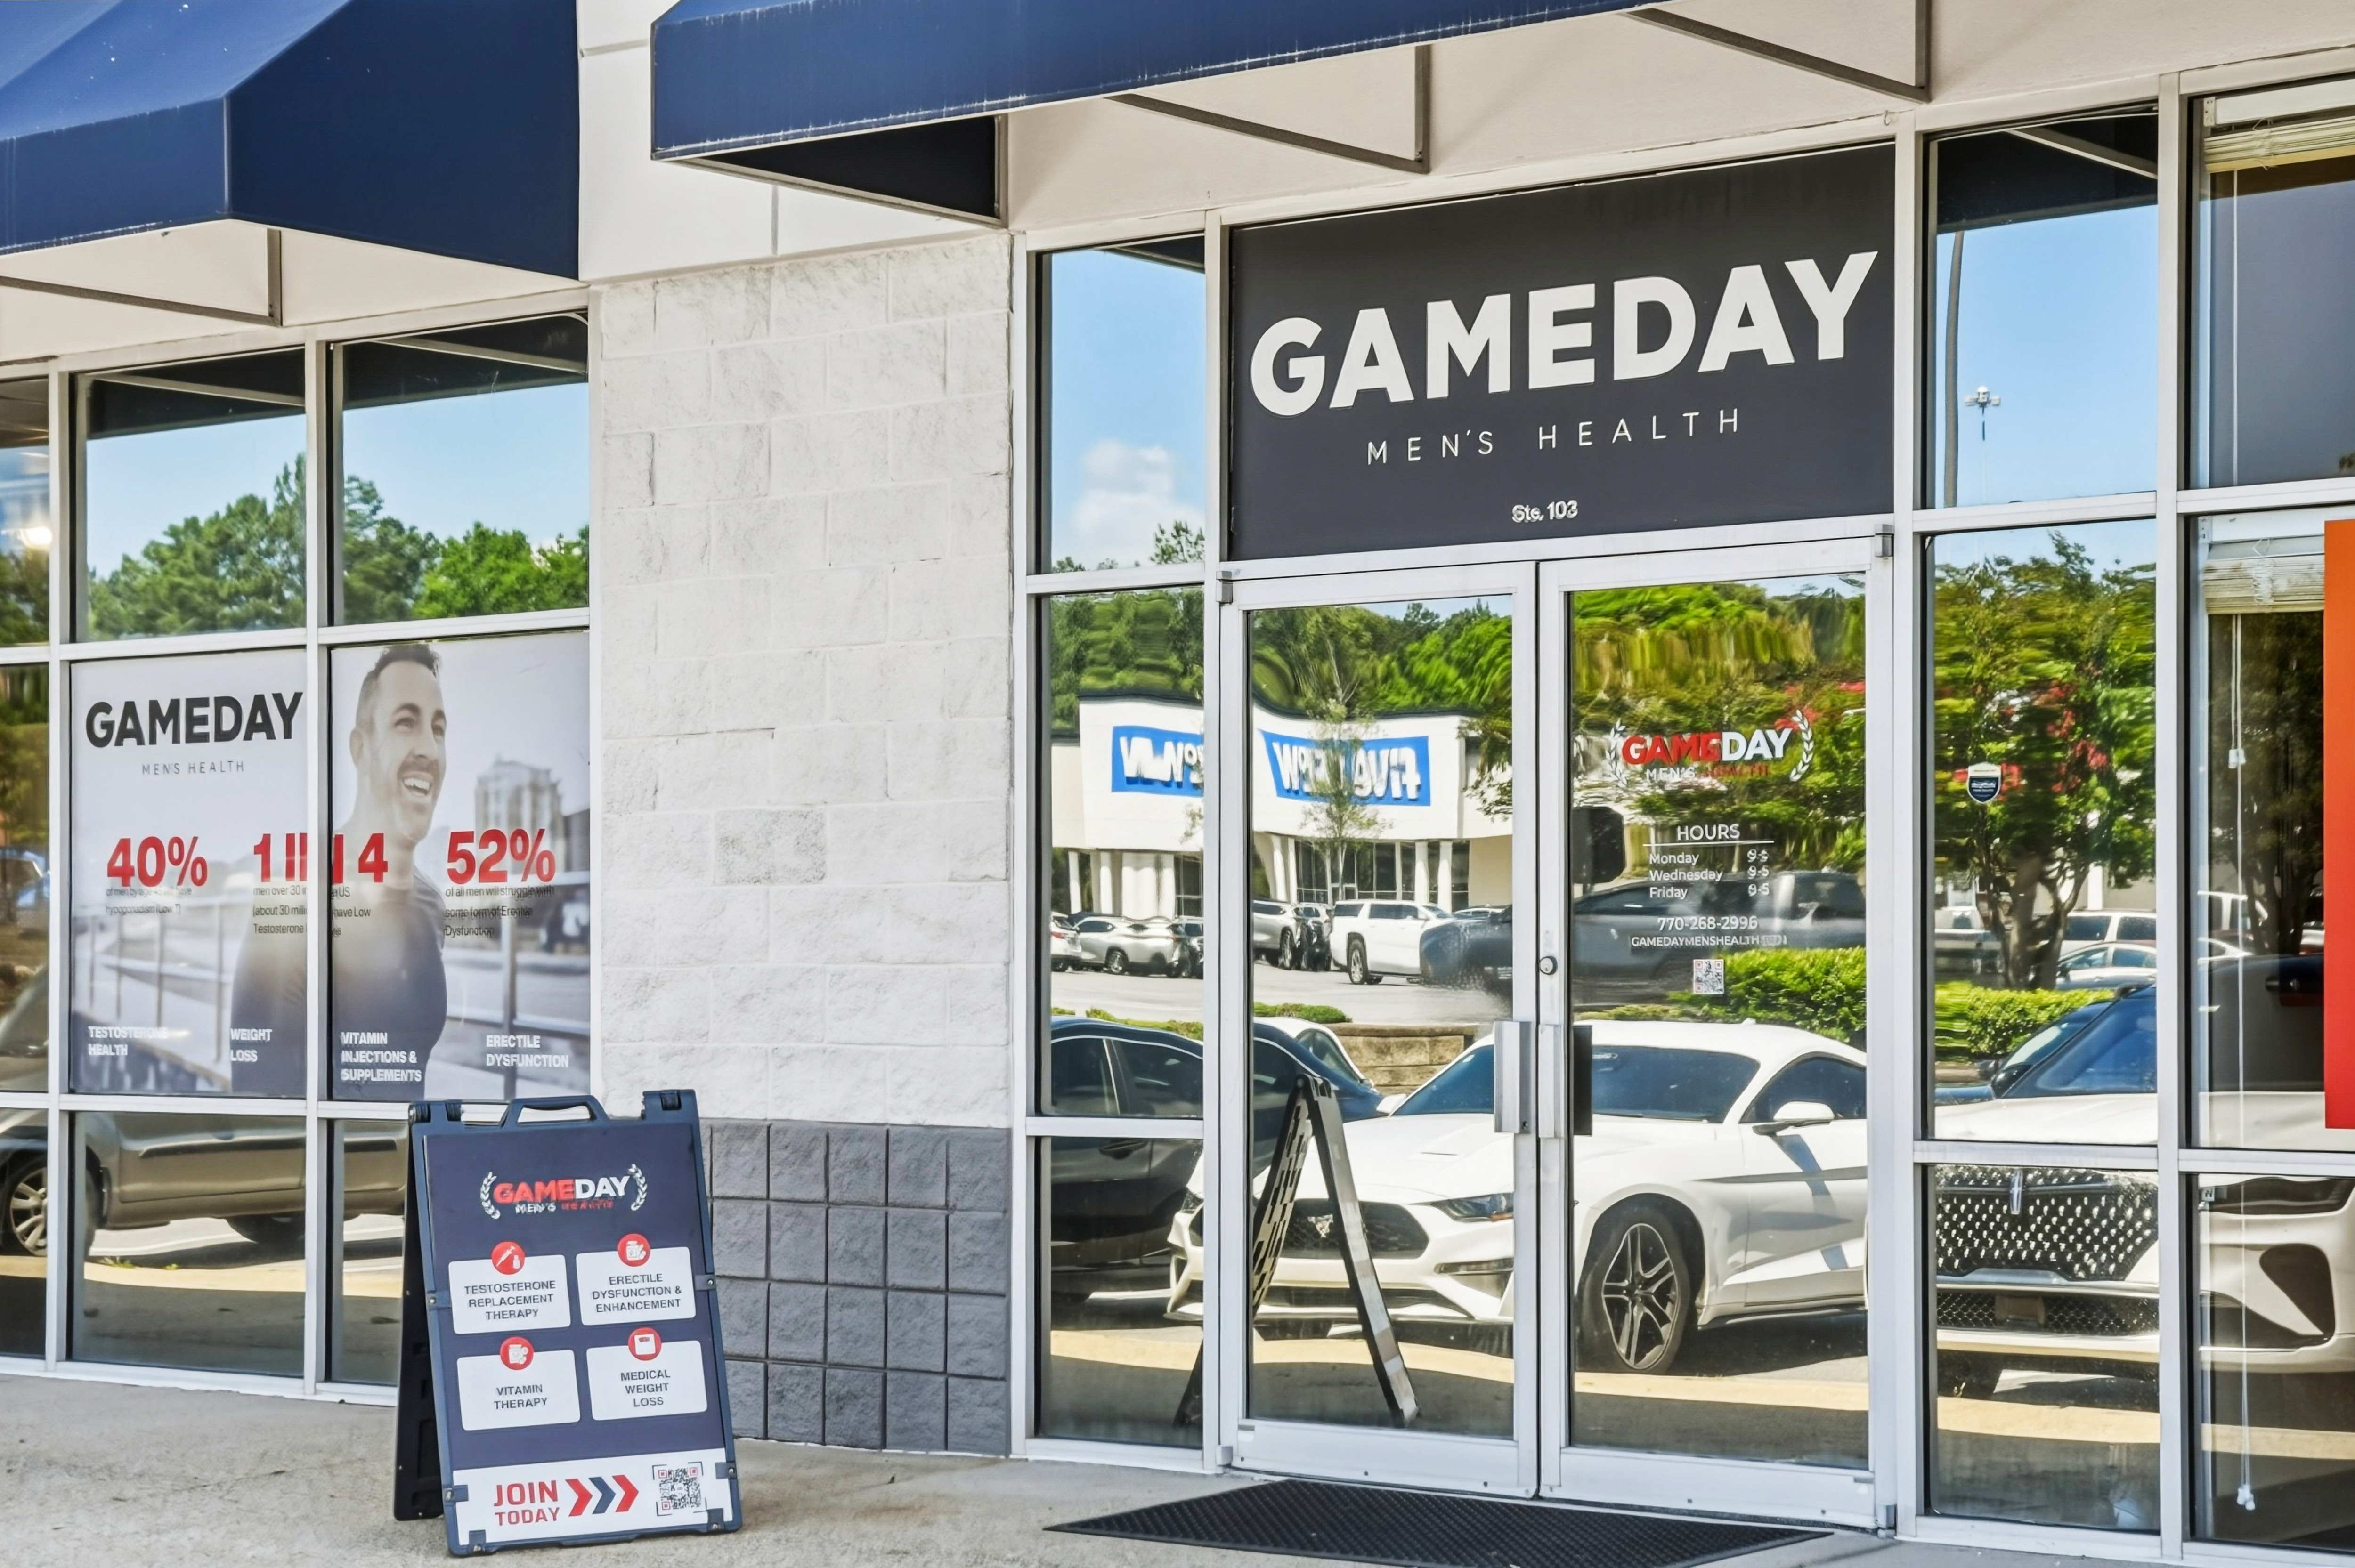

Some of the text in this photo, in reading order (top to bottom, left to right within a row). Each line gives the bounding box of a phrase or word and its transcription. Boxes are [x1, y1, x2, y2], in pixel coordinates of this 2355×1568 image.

[1250, 251, 1878, 416] GAMEDAY
[1368, 408, 1739, 465] MEN'S HEALTH
[1512, 500, 1578, 523] Ste. 103
[86, 692, 303, 748] GAMEDAY
[1622, 728, 1793, 765] GAMEDAY
[142, 760, 244, 775] MEN'S HEALTH
[1646, 767, 1696, 781] MEN'S
[1677, 823, 1740, 841] HOURS
[107, 836, 208, 887] 40%
[253, 833, 271, 882] 1
[358, 833, 388, 883] 4
[447, 828, 556, 885] 52%
[1649, 852, 1699, 865] Monday
[1649, 869, 1723, 882] Wednesday
[253, 887, 270, 896] men
[271, 887, 288, 895] over
[291, 885, 301, 895] 30
[339, 886, 350, 897] US
[446, 887, 454, 897] of
[455, 886, 464, 897] all
[466, 888, 484, 896] men
[486, 886, 499, 896] will
[1649, 883, 1770, 900] Friday 9-5
[253, 905, 307, 916] (about 30 milli
[354, 907, 371, 917] Low
[253, 923, 304, 934] Testosterone
[445, 925, 494, 938] Dysfunction
[88, 1026, 169, 1039] TESTOSTERONE
[230, 1028, 272, 1042] WEIGHT
[341, 1032, 388, 1045] VITAMIN
[486, 1035, 541, 1049] ERECTILE
[88, 1043, 128, 1056] HEALTH
[230, 1049, 258, 1062] LOSS
[341, 1051, 417, 1064] INJECTIONS &
[486, 1053, 569, 1068] DYSFUNCTION
[341, 1068, 422, 1082] SUPPLEMENTS
[493, 1175, 631, 1204] GAMEDAY
[609, 1273, 663, 1286] ERECTILE
[464, 1280, 556, 1295] TESTOSTERONE
[592, 1285, 682, 1300] DYSFUNCTION &
[468, 1293, 554, 1308] REPLACEMENT
[596, 1298, 681, 1313] ENHANCEMENT
[486, 1308, 540, 1321] THERAPY
[620, 1368, 671, 1382] MEDICAL
[496, 1383, 544, 1397] VITAMIN
[625, 1382, 670, 1395] WEIGHT
[494, 1397, 548, 1410] THERAPY
[633, 1396, 665, 1407] LOSS
[494, 1479, 559, 1507] JOIN
[495, 1507, 560, 1526] TODAY
